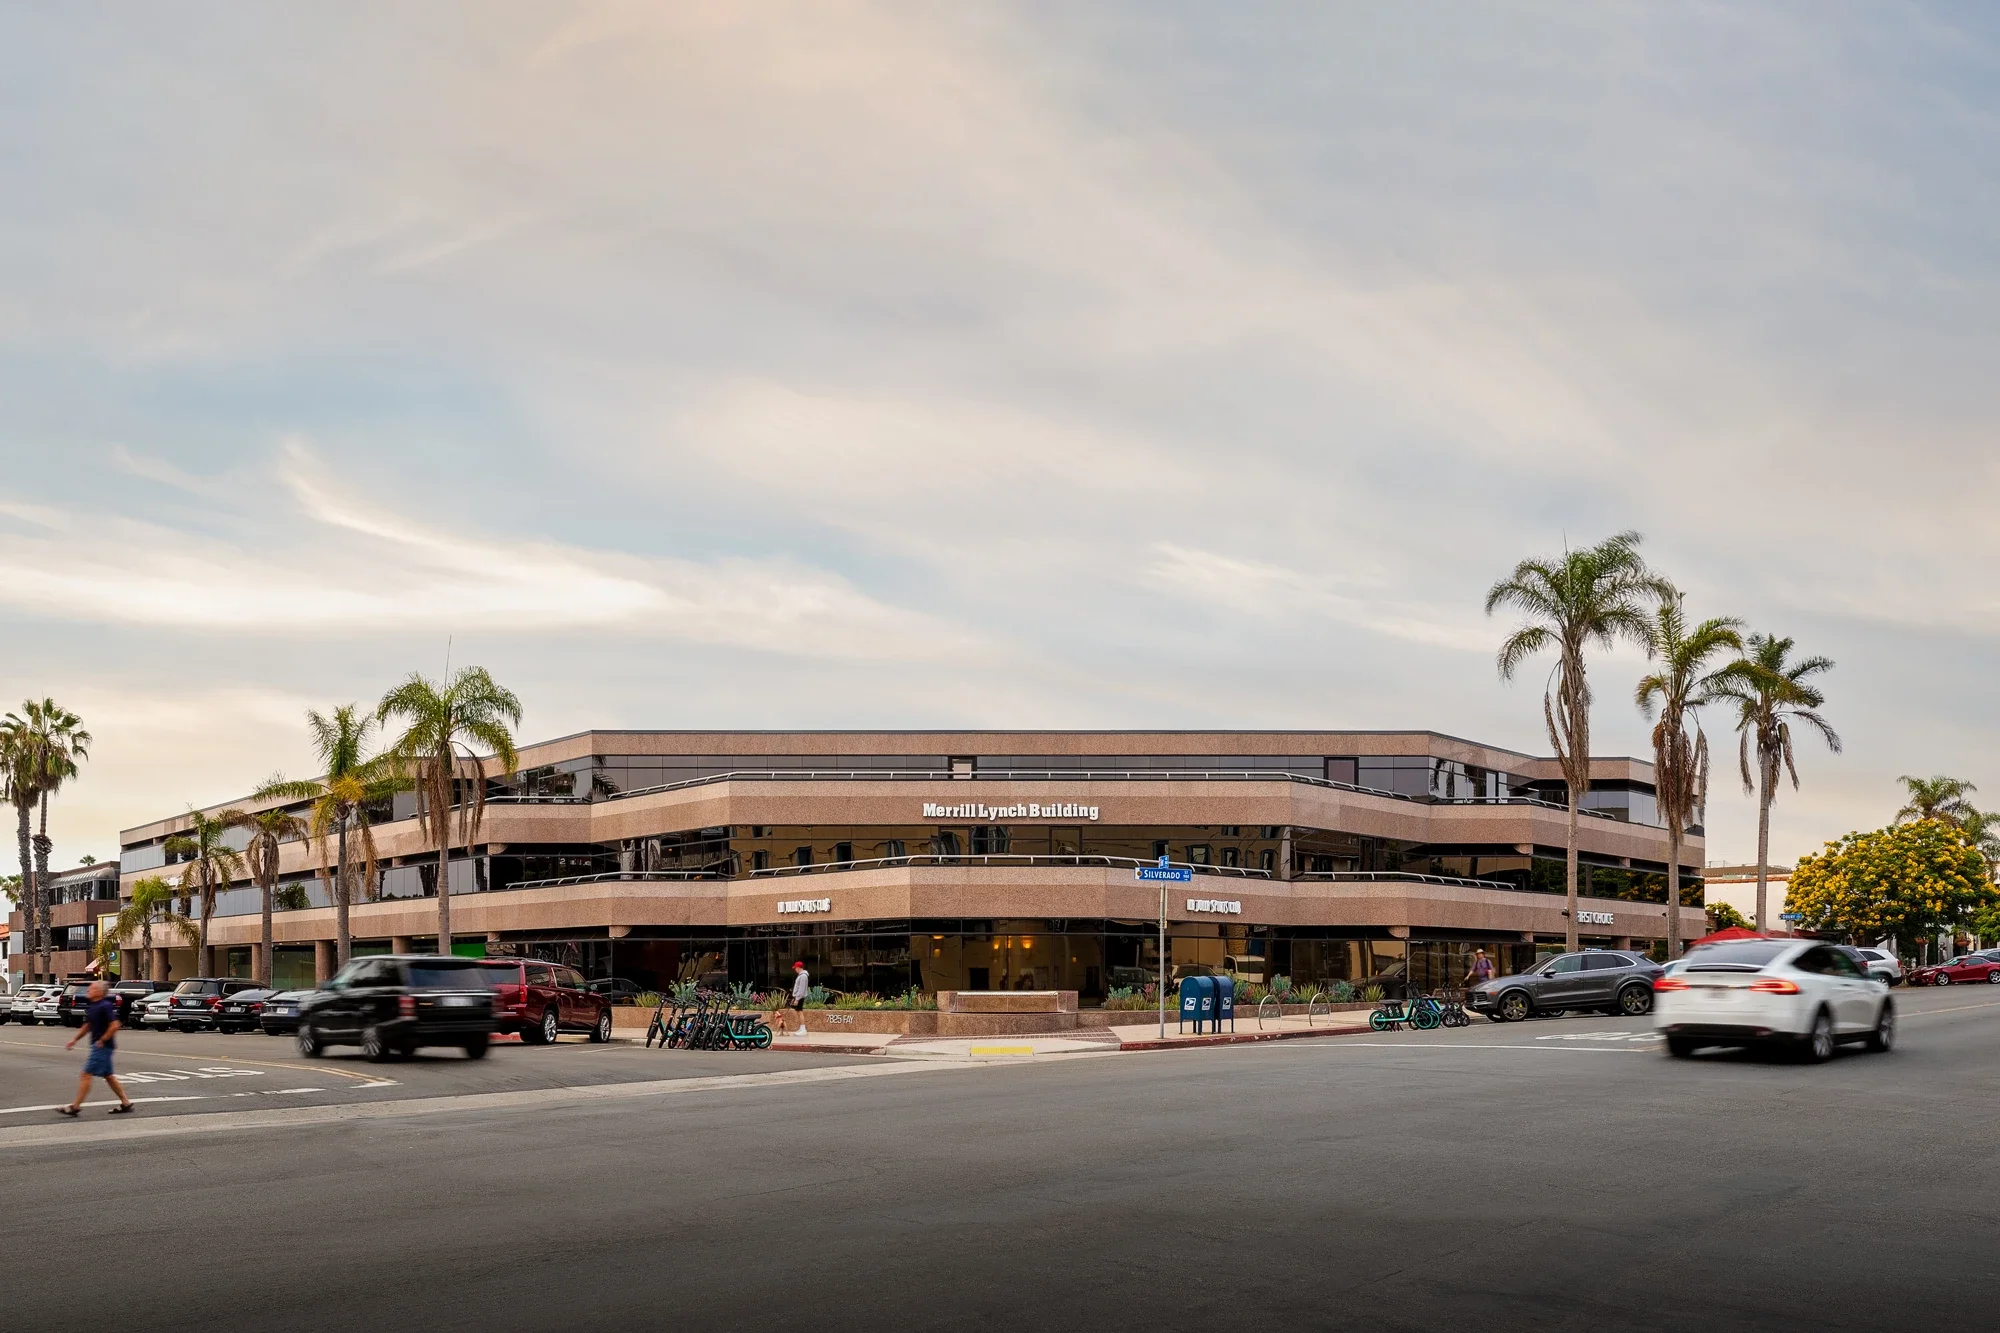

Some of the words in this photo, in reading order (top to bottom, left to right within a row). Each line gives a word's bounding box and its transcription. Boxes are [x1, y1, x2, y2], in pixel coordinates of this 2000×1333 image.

[923, 803, 976, 817] Merrill
[978, 803, 1027, 821] Lynch
[1029, 803, 1099, 821] Building
[1144, 869, 1181, 880] SILVERADO
[1592, 912, 1614, 924] CHOICE
[826, 1014, 842, 1024] 7825
